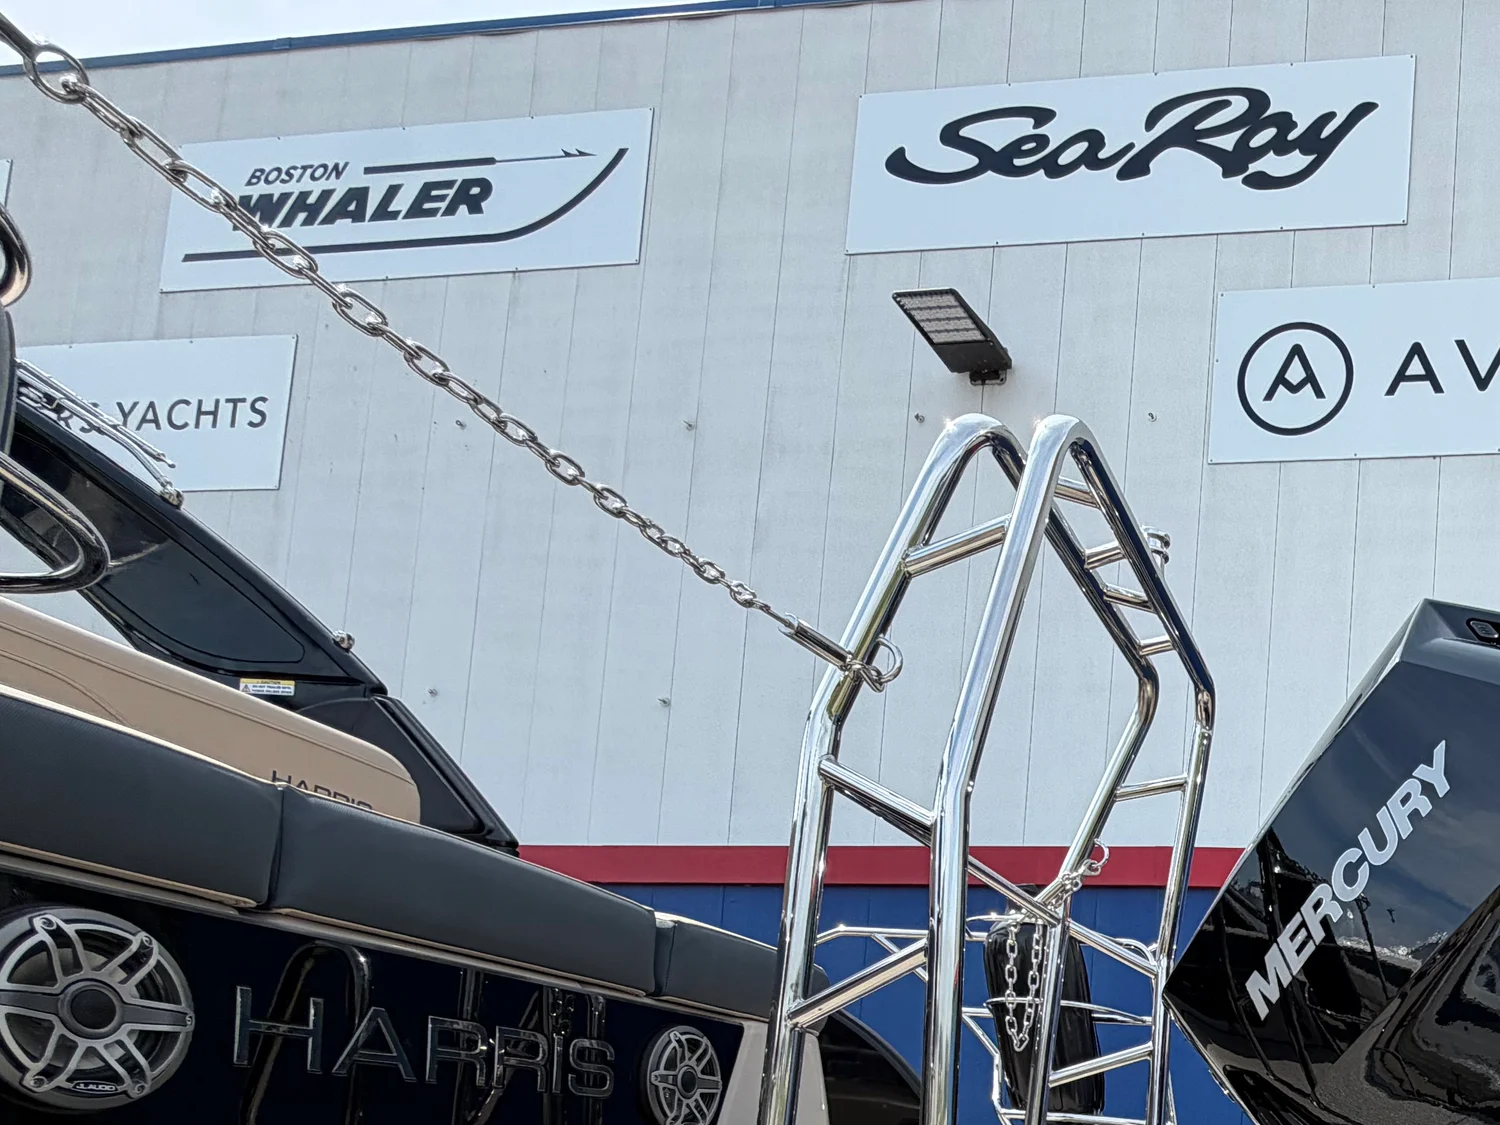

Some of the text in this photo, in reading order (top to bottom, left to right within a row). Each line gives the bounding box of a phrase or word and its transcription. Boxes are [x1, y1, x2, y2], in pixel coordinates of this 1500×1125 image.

[244, 161, 350, 187] BOSTON
[885, 87, 1379, 191] Sea Ray
[232, 177, 493, 231] WHALER
[116, 396, 269, 432] YACHTS
[1245, 740, 1451, 1021] MERCURY
[233, 985, 616, 1098] HARRIS
